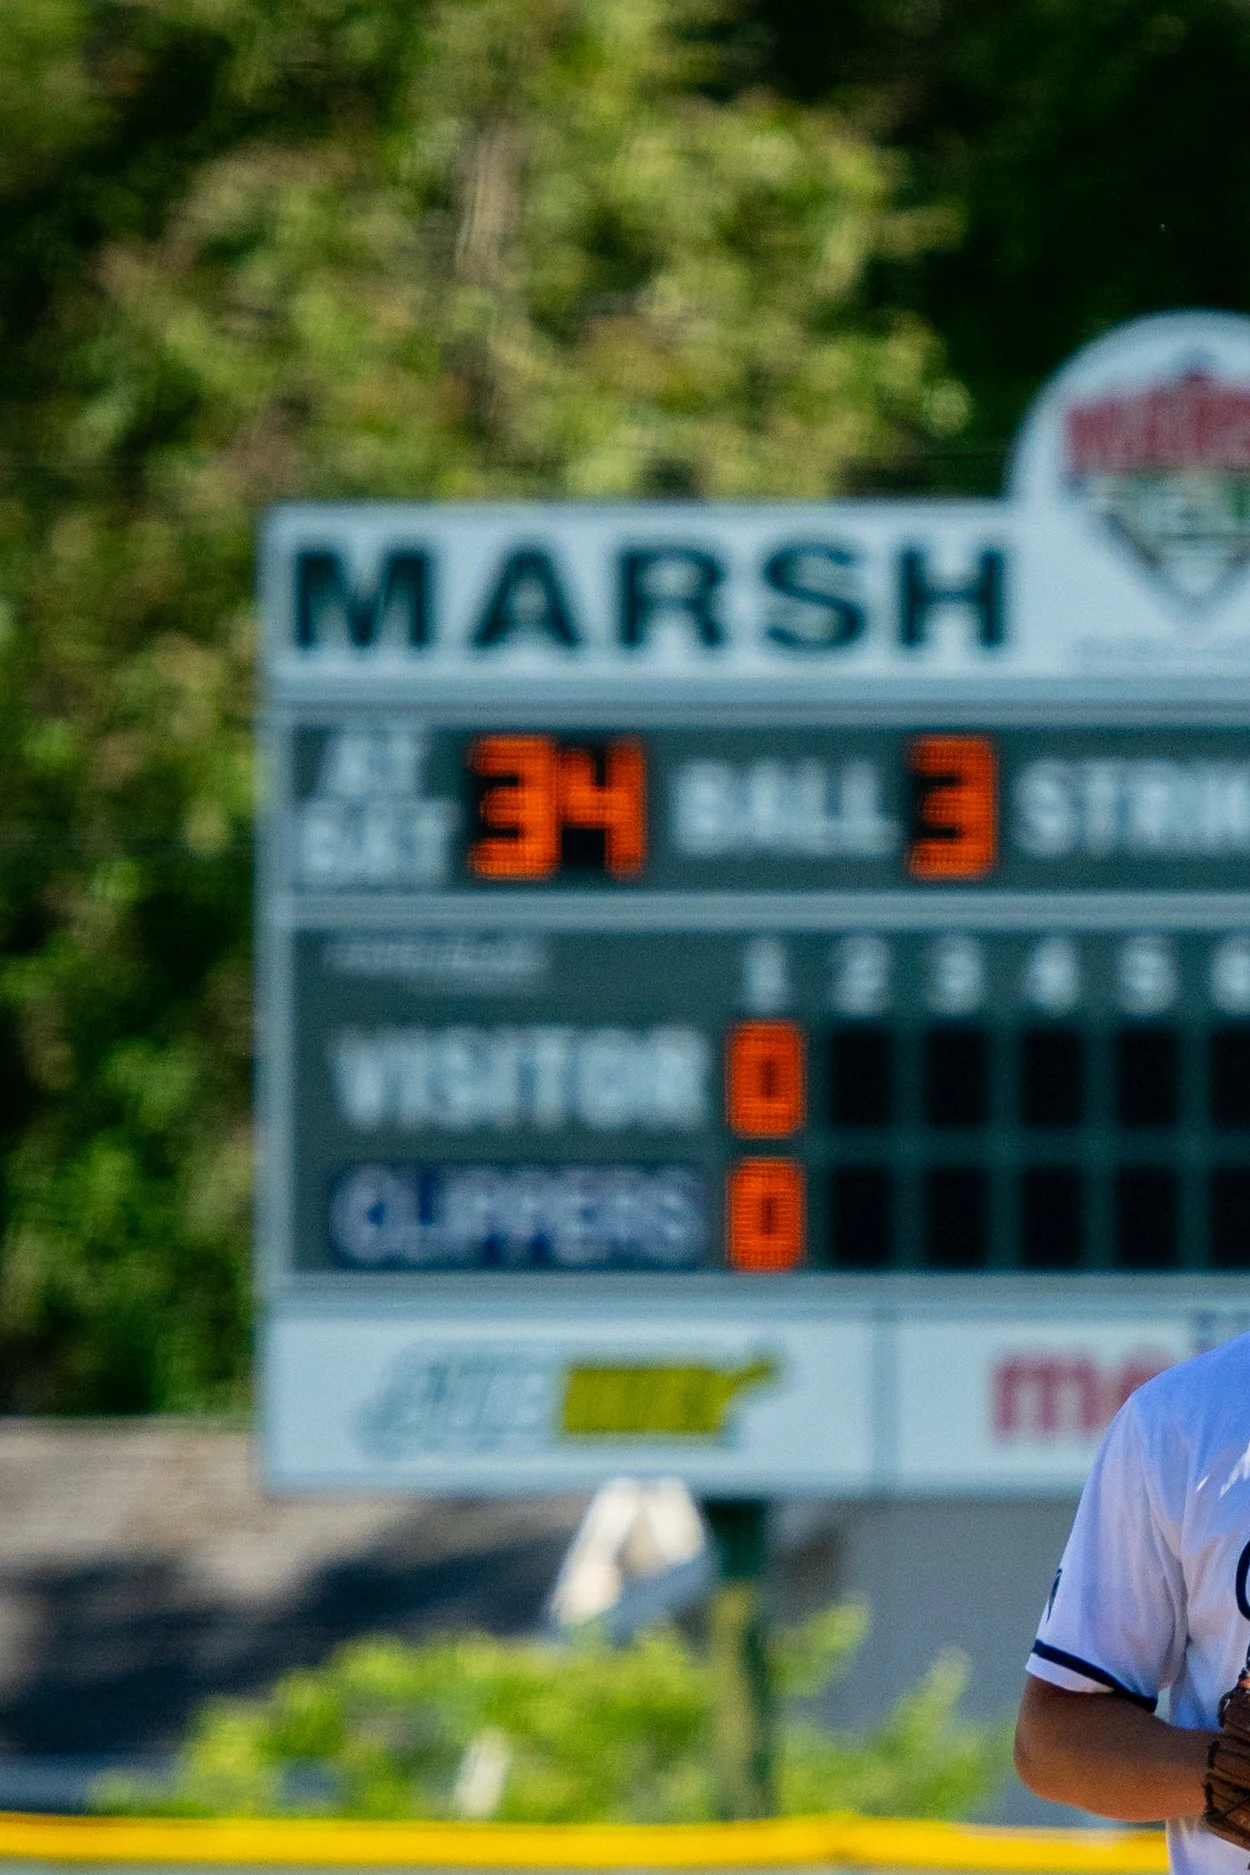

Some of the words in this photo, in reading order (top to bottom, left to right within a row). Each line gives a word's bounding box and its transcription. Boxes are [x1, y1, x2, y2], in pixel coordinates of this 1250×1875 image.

[294, 545, 1006, 651] MARSH
[467, 735, 648, 880] 34
[668, 758, 896, 856] BALL
[908, 735, 999, 880] 3
[330, 1024, 709, 1134] VISITOR
[726, 1019, 807, 1139] 0
[332, 1164, 704, 1264] CLIPPERS
[726, 1156, 807, 1275] 0
